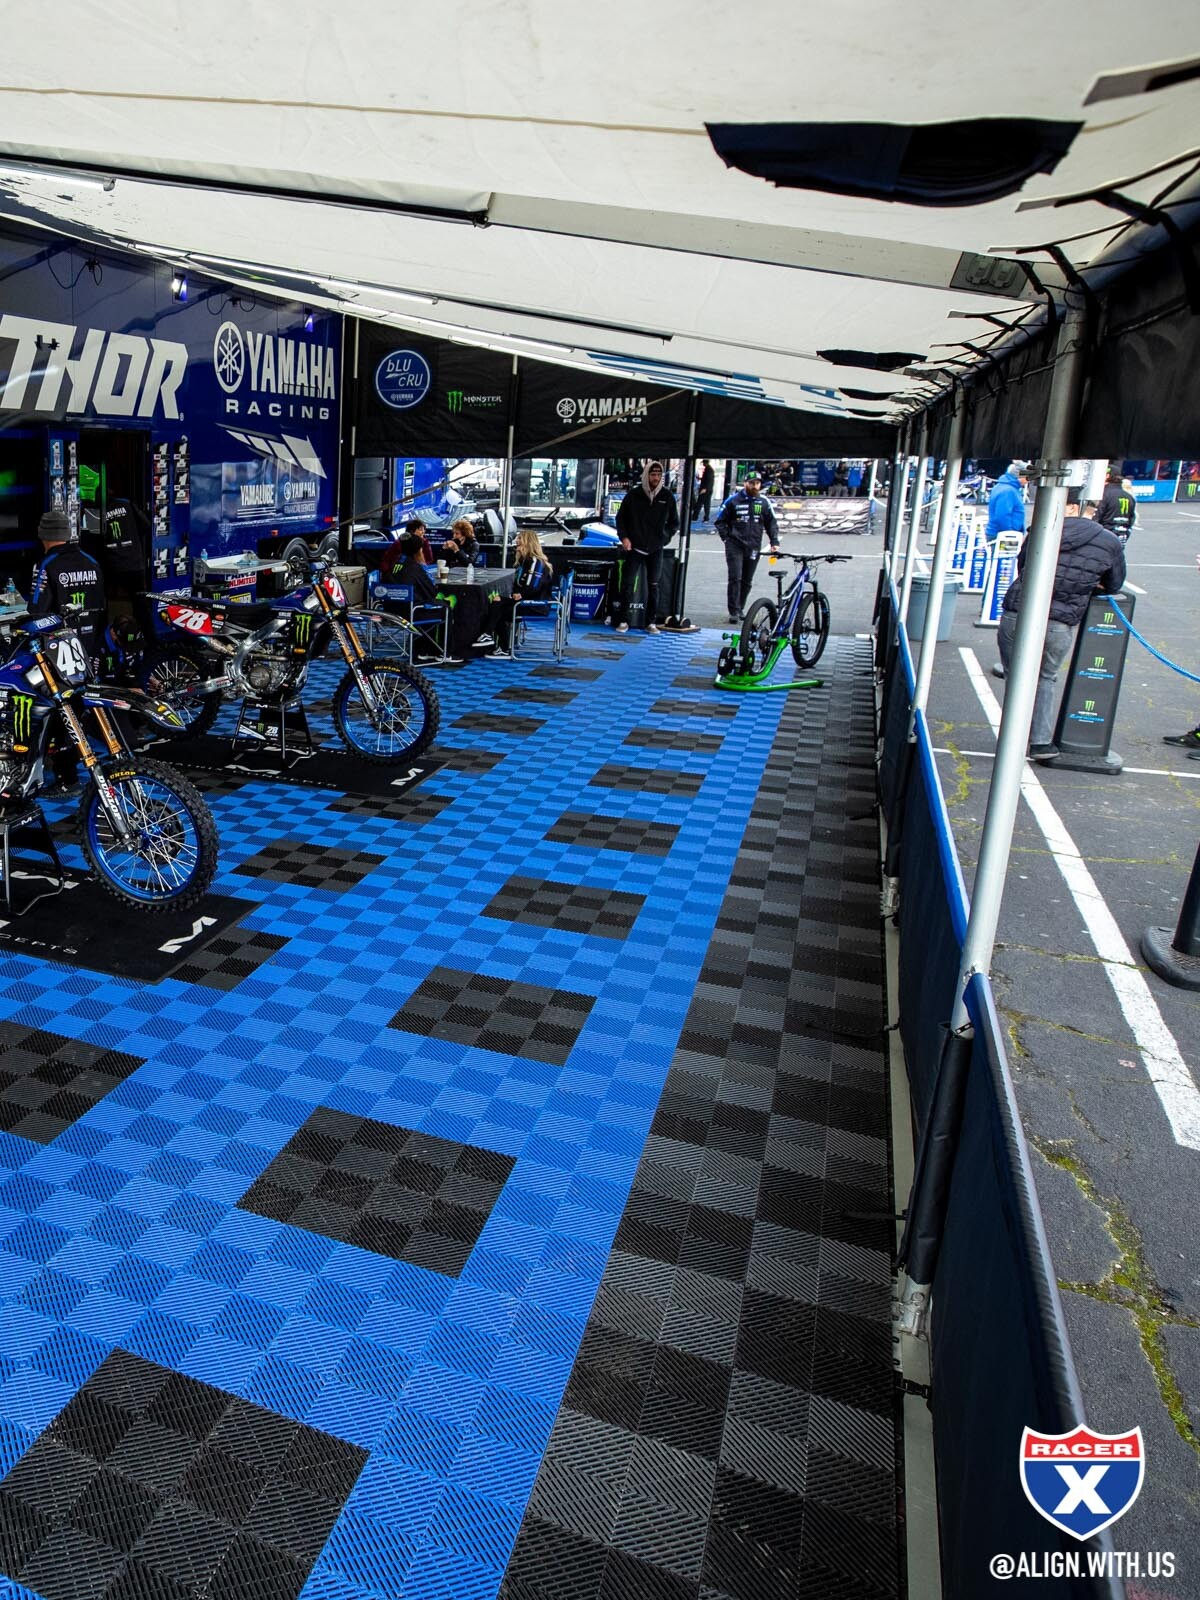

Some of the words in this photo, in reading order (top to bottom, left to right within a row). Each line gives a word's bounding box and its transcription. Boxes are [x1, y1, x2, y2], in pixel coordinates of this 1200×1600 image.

[246, 331, 335, 400] YAMAHA
[226, 399, 329, 420] RACING
[464, 395, 502, 403] MONSTER
[577, 397, 648, 417] YAMAHA
[240, 484, 274, 506] YAMALUBE
[68, 570, 97, 582] YAMAHA
[172, 609, 209, 630] 28
[57, 638, 86, 676] 49
[98, 775, 122, 820] DUNLOP
